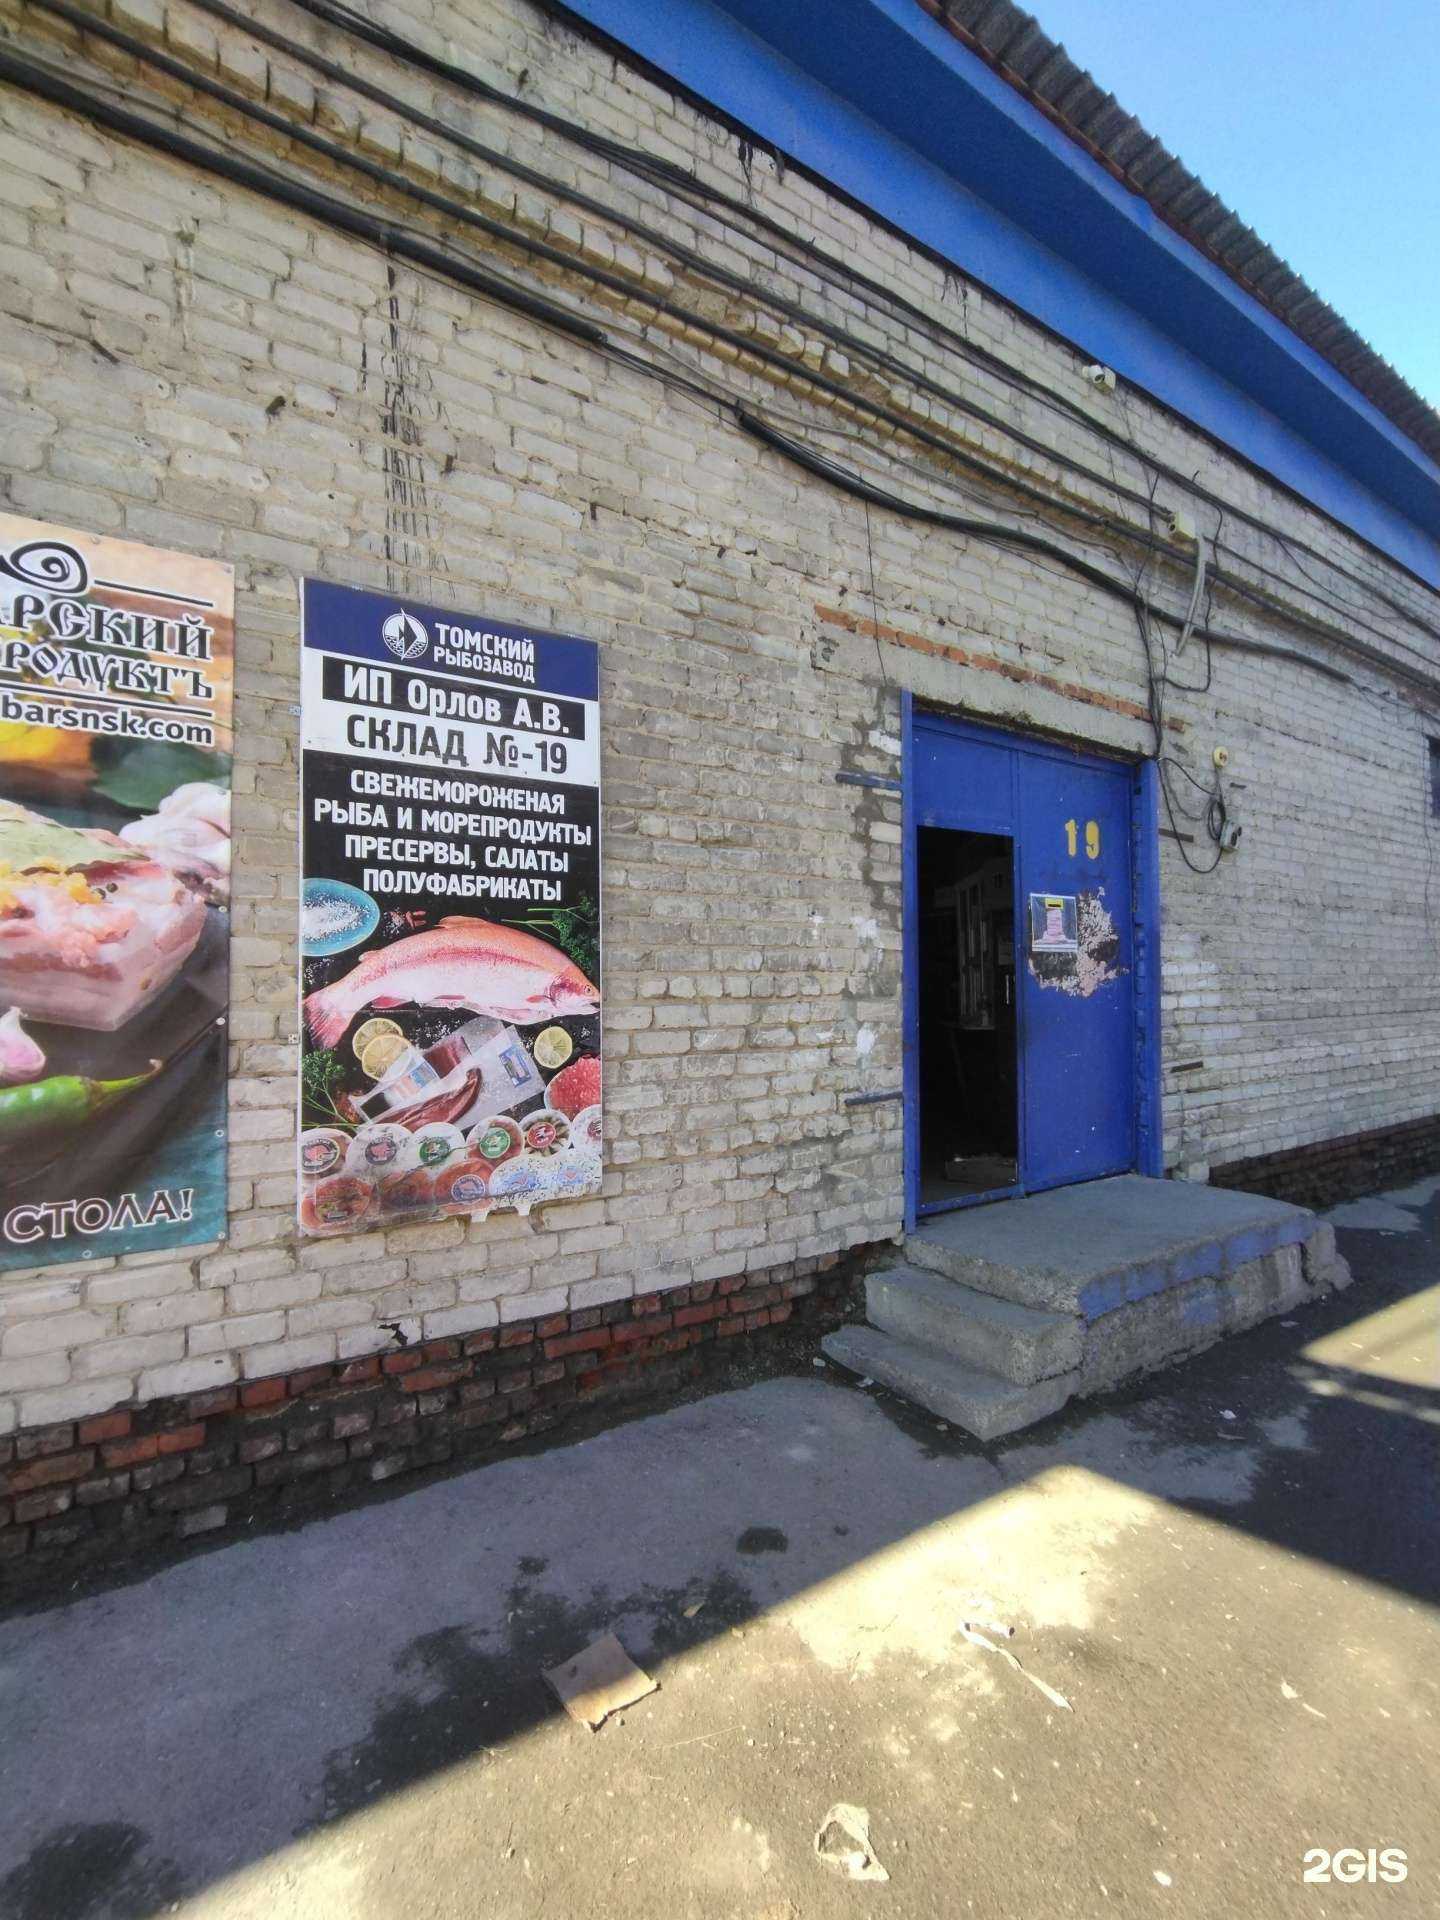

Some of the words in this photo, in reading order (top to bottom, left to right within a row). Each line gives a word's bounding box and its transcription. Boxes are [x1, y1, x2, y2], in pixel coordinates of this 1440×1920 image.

[0, 594, 213, 660] РСКИЙ
[434, 622, 535, 663] ТОМСКИЙ
[433, 646, 536, 684] РЫБОЗАВОД
[1, 694, 213, 744] barsnsk.com
[343, 664, 392, 705] ИП
[407, 679, 502, 722] Орлов
[512, 698, 570, 733] А.В.
[346, 714, 469, 767] СКЛАД
[483, 731, 568, 775] №-19
[350, 769, 565, 814] СВЕЖЕМОРОЖЕНАЯ
[314, 798, 388, 828] РЫБА
[397, 806, 412, 829] И
[421, 808, 592, 846] МОРЕПРОДУКТЫ
[1065, 818, 1100, 860] 19
[345, 834, 476, 870] ПРЕСЕРВЫ,
[484, 848, 569, 873] САЛАТЫ
[363, 868, 562, 901] ПОЛУФАБРИКАТЫ
[3, 1188, 194, 1243] СТОЛА!
